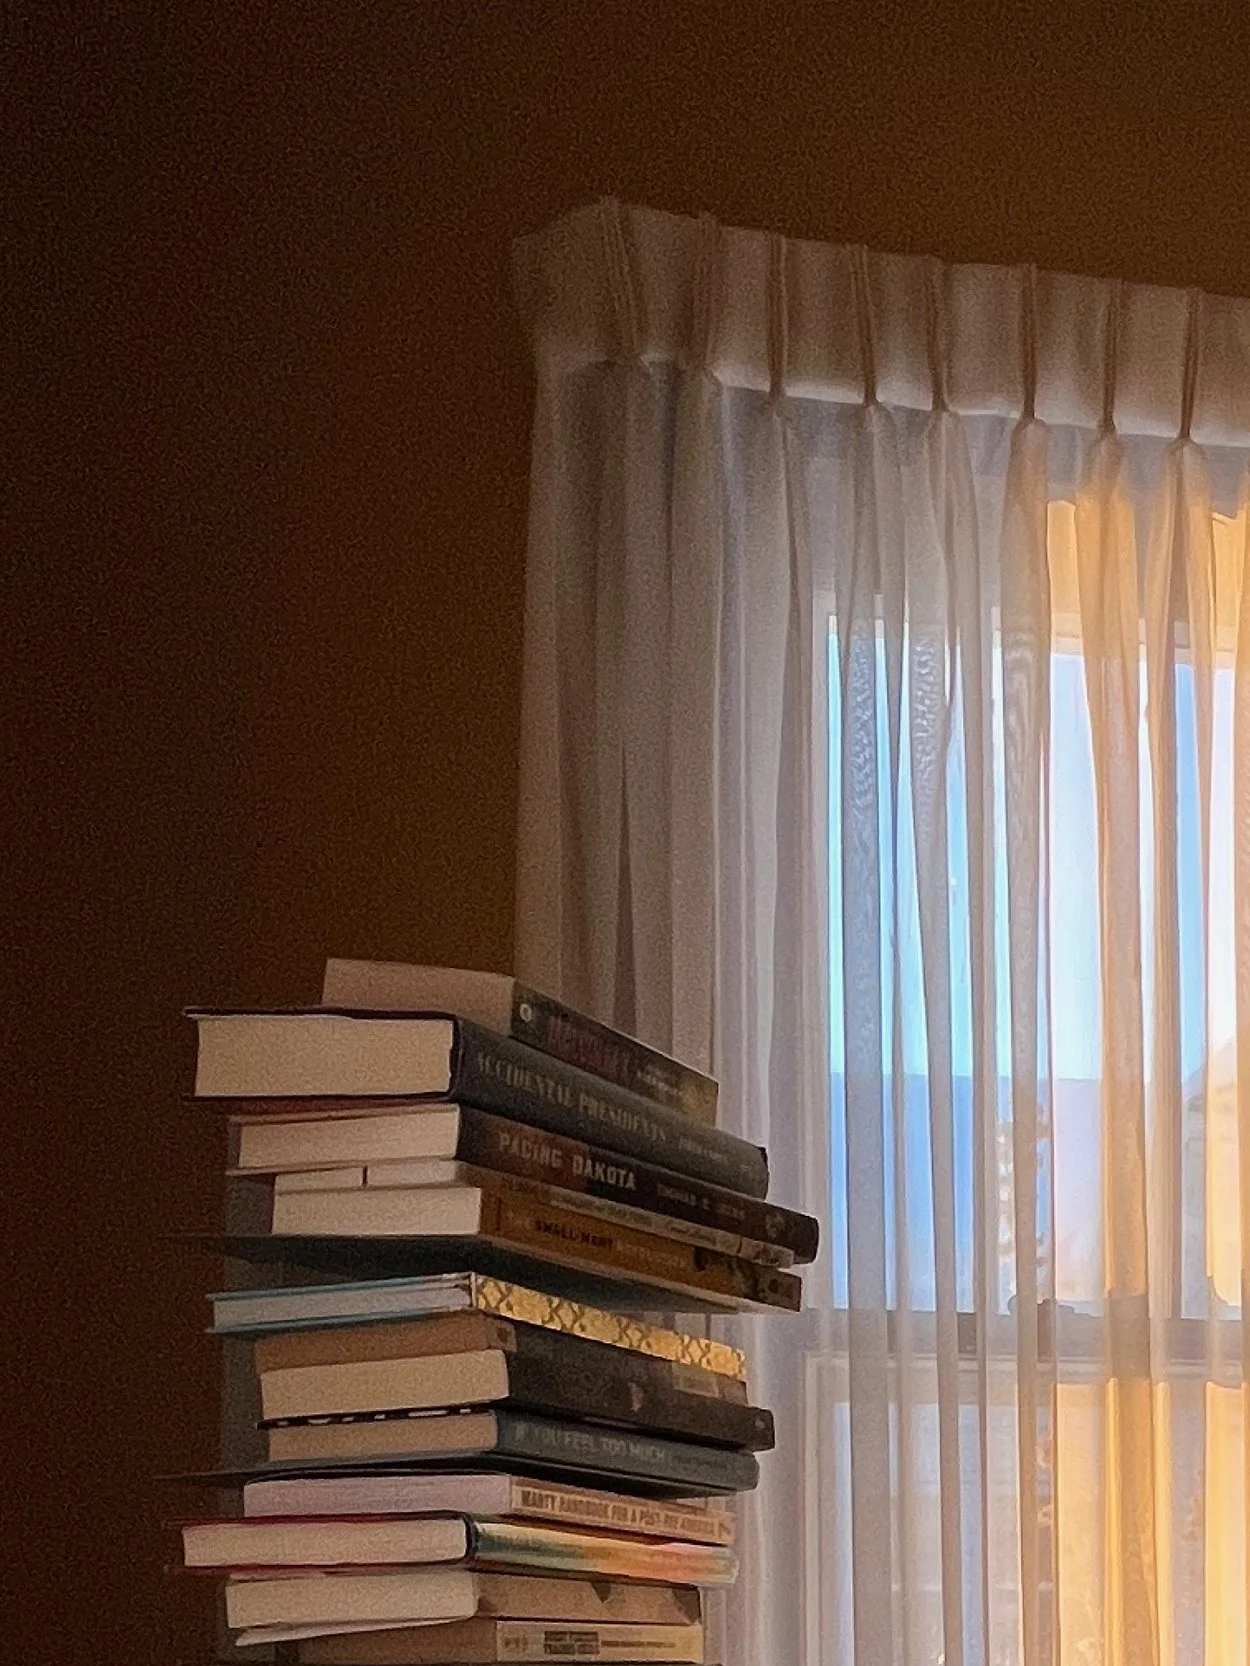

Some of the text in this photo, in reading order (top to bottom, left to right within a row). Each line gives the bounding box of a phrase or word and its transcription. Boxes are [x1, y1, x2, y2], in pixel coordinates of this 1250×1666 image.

[578, 1093, 667, 1142] PRESIDENTS
[501, 1132, 562, 1170] PACING
[572, 1154, 637, 1191] DAKOTA
